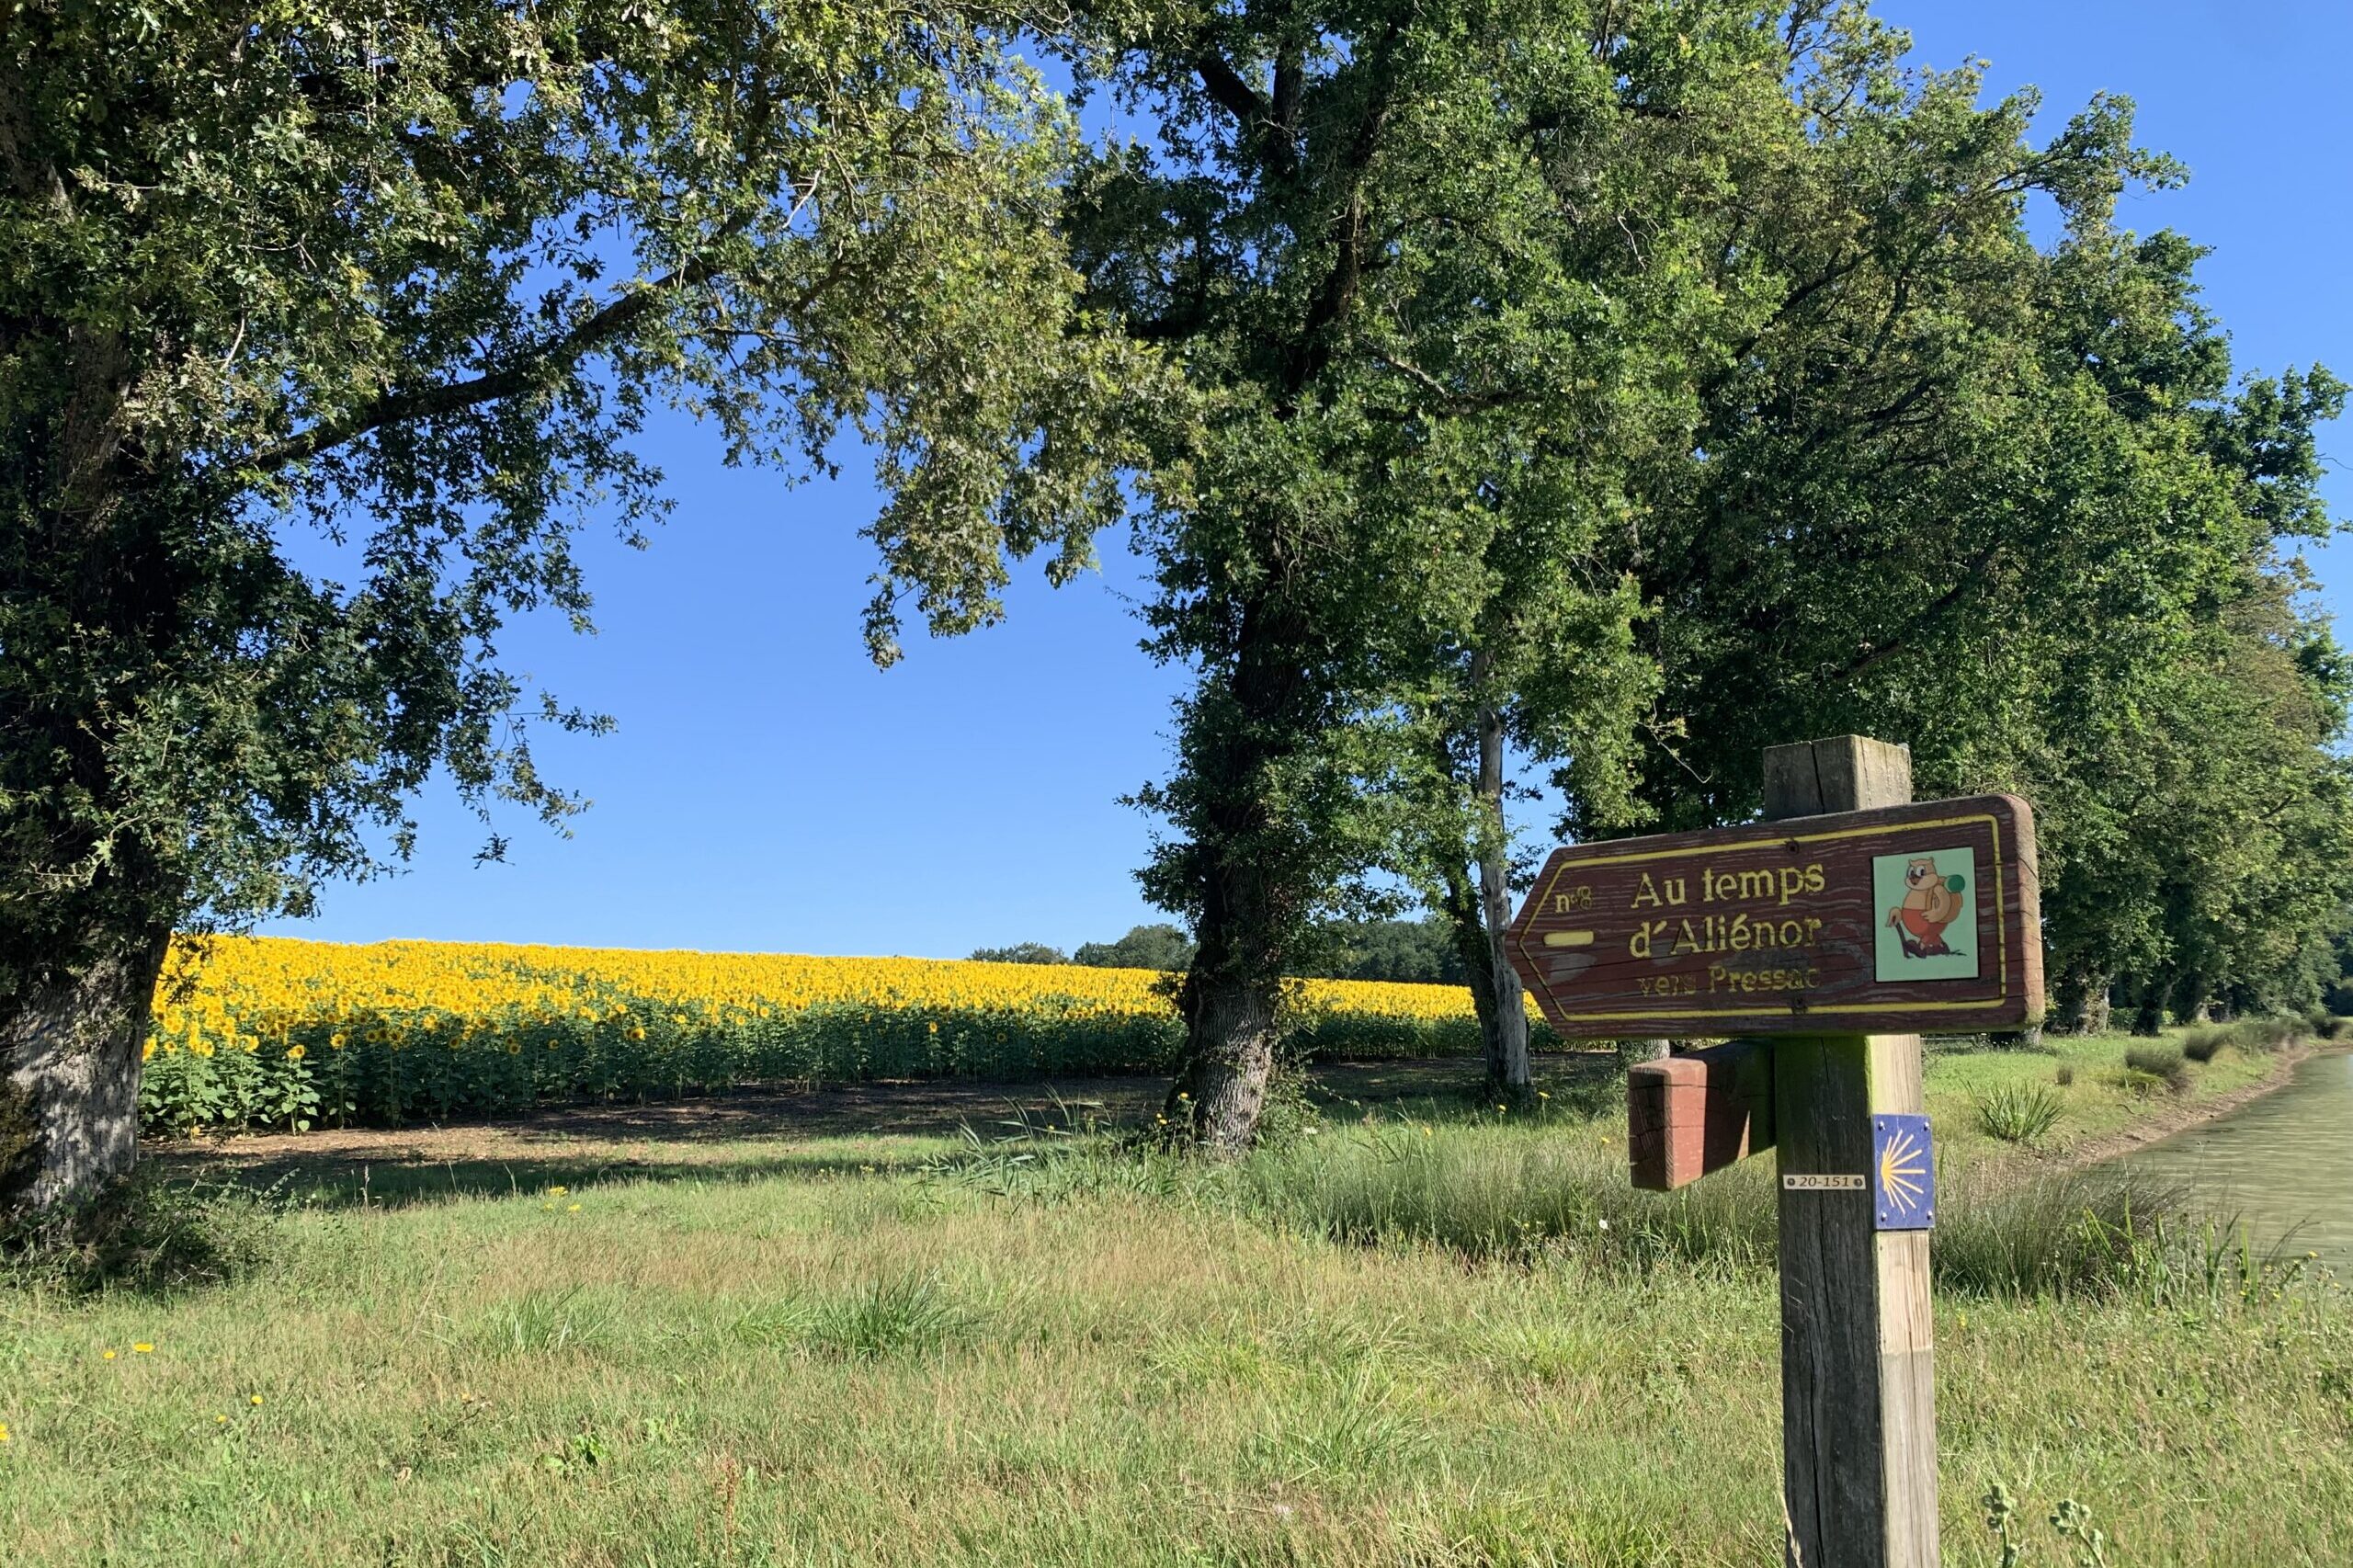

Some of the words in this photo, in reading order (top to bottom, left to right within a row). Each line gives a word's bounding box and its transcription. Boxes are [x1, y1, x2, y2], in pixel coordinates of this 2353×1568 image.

[1631, 872, 1687, 909] Au
[1701, 863, 1826, 906] temps
[1799, 1176, 1849, 1187] 20-151
